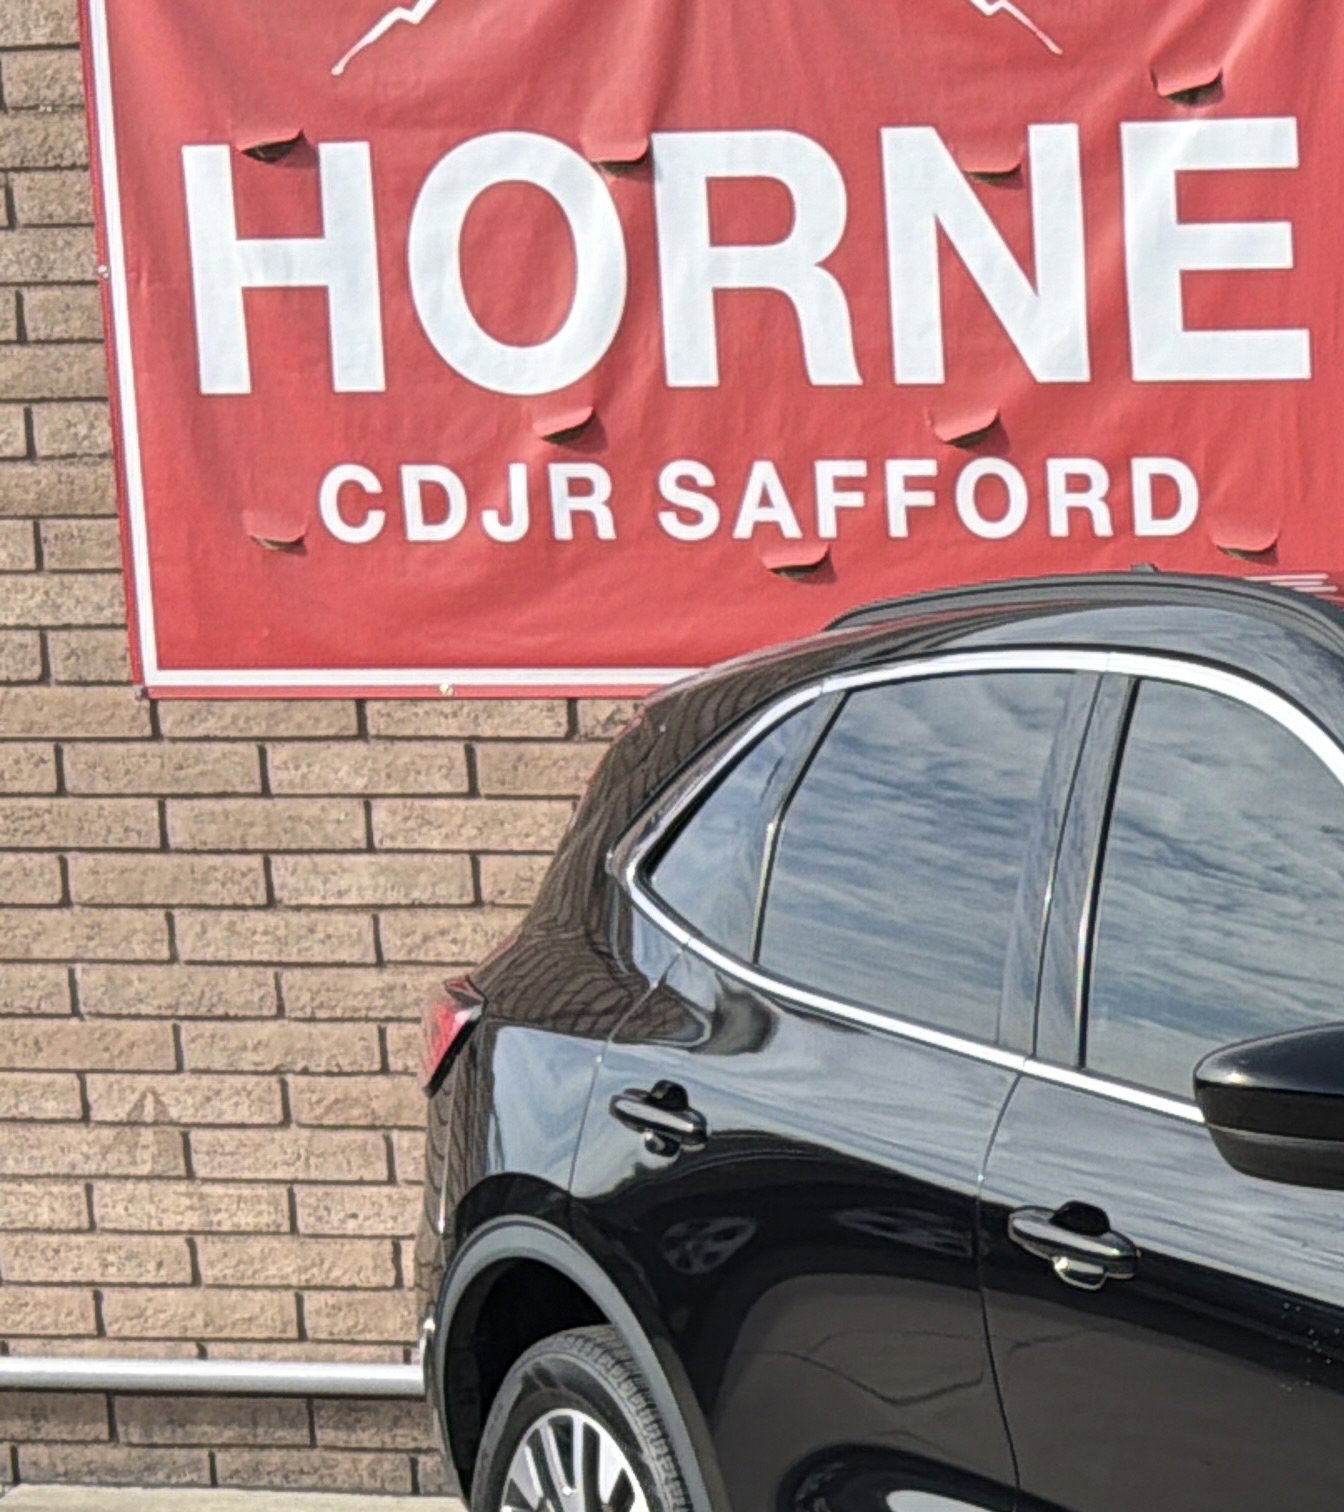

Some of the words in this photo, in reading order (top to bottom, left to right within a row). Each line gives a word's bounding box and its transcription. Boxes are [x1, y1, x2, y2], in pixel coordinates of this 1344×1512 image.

[182, 118, 1311, 394] HORNE
[319, 462, 616, 544] CDJR
[656, 457, 1199, 541] SAFFORD
